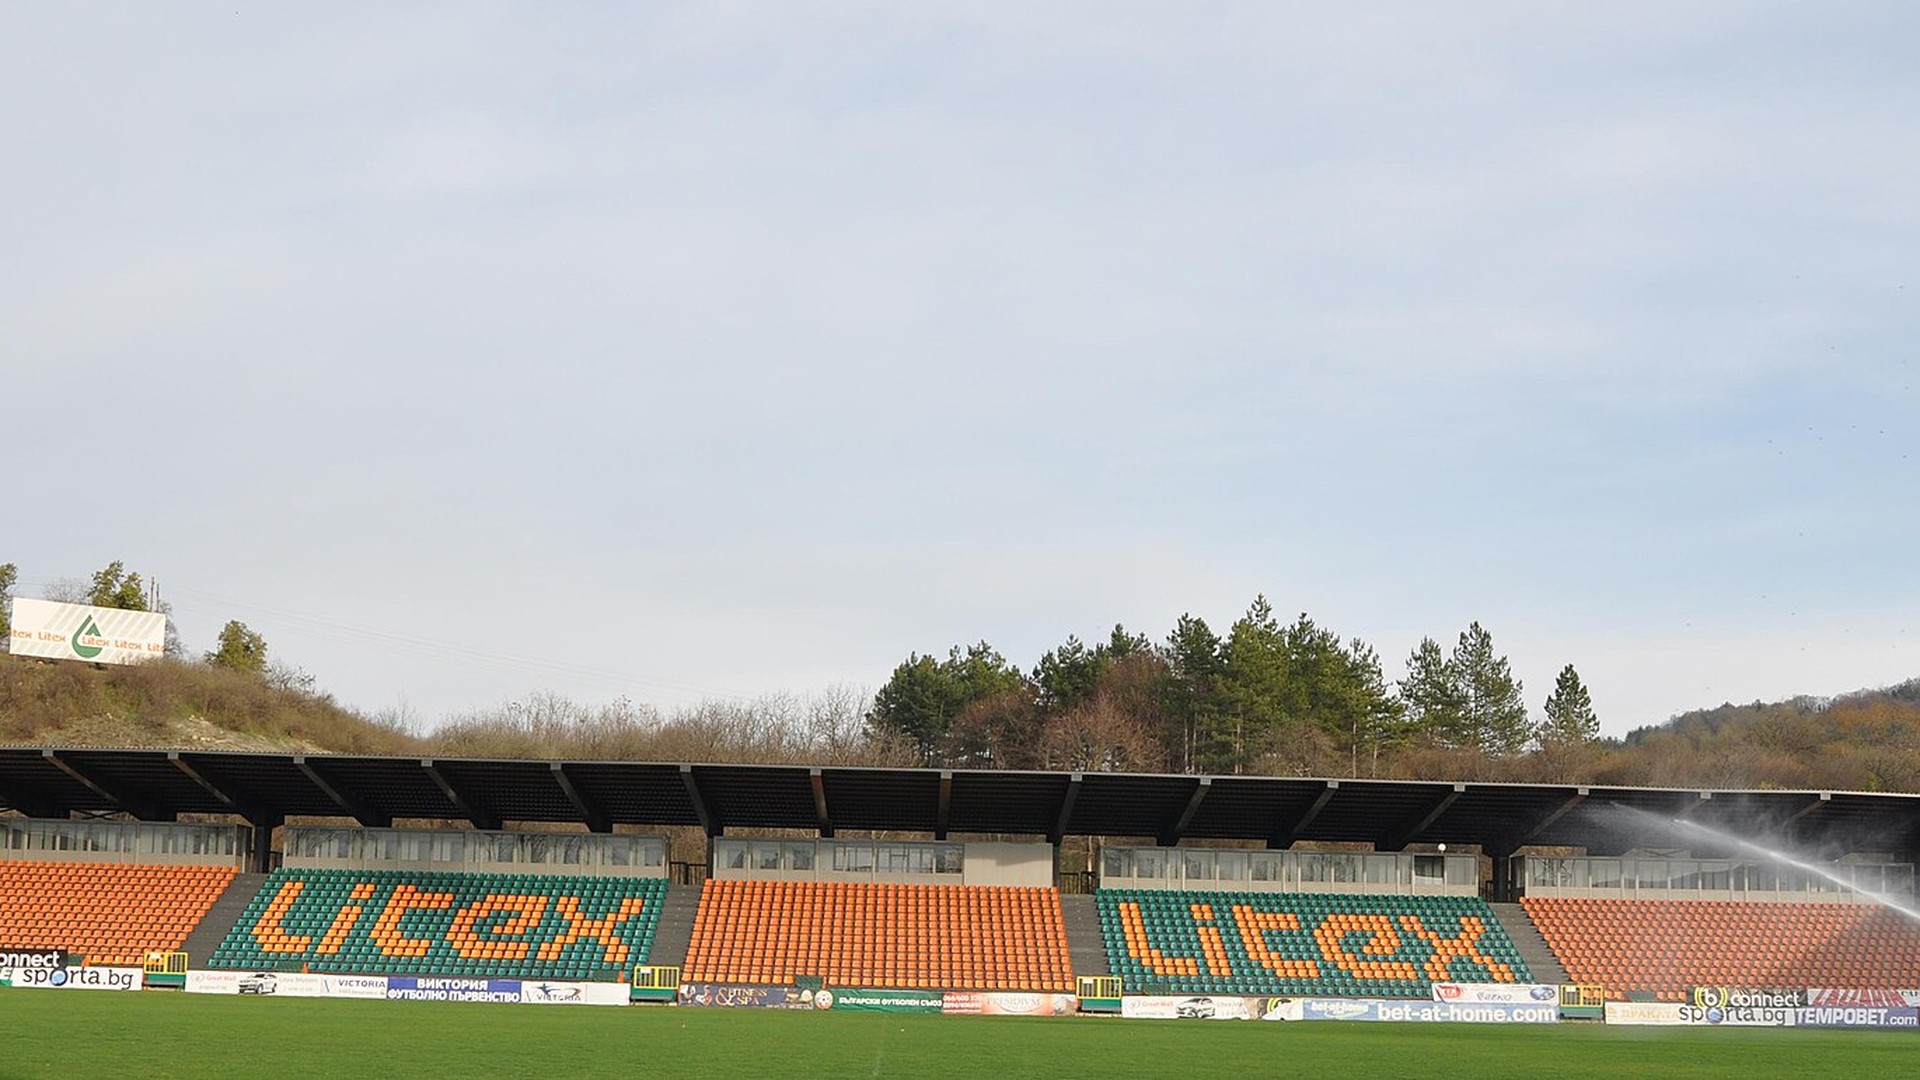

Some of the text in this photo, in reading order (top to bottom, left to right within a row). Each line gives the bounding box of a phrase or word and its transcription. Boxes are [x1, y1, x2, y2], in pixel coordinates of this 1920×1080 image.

[250, 881, 643, 962] Litex
[1117, 901, 1517, 982] Litex
[23, 968, 134, 990] sporta.bg
[338, 978, 386, 989] VICTORIA
[416, 978, 489, 991] ВИКТОРИЯ
[387, 988, 446, 1001] ФУТБОЛНО
[450, 990, 520, 1003] ПЪРВЕНСТВО
[1730, 991, 1800, 1007] connect
[1377, 1003, 1557, 1022] bet-at-home.com
[1679, 1005, 1786, 1024] sporta.bg
[1795, 1008, 1918, 1026] TEMPOBET.com
